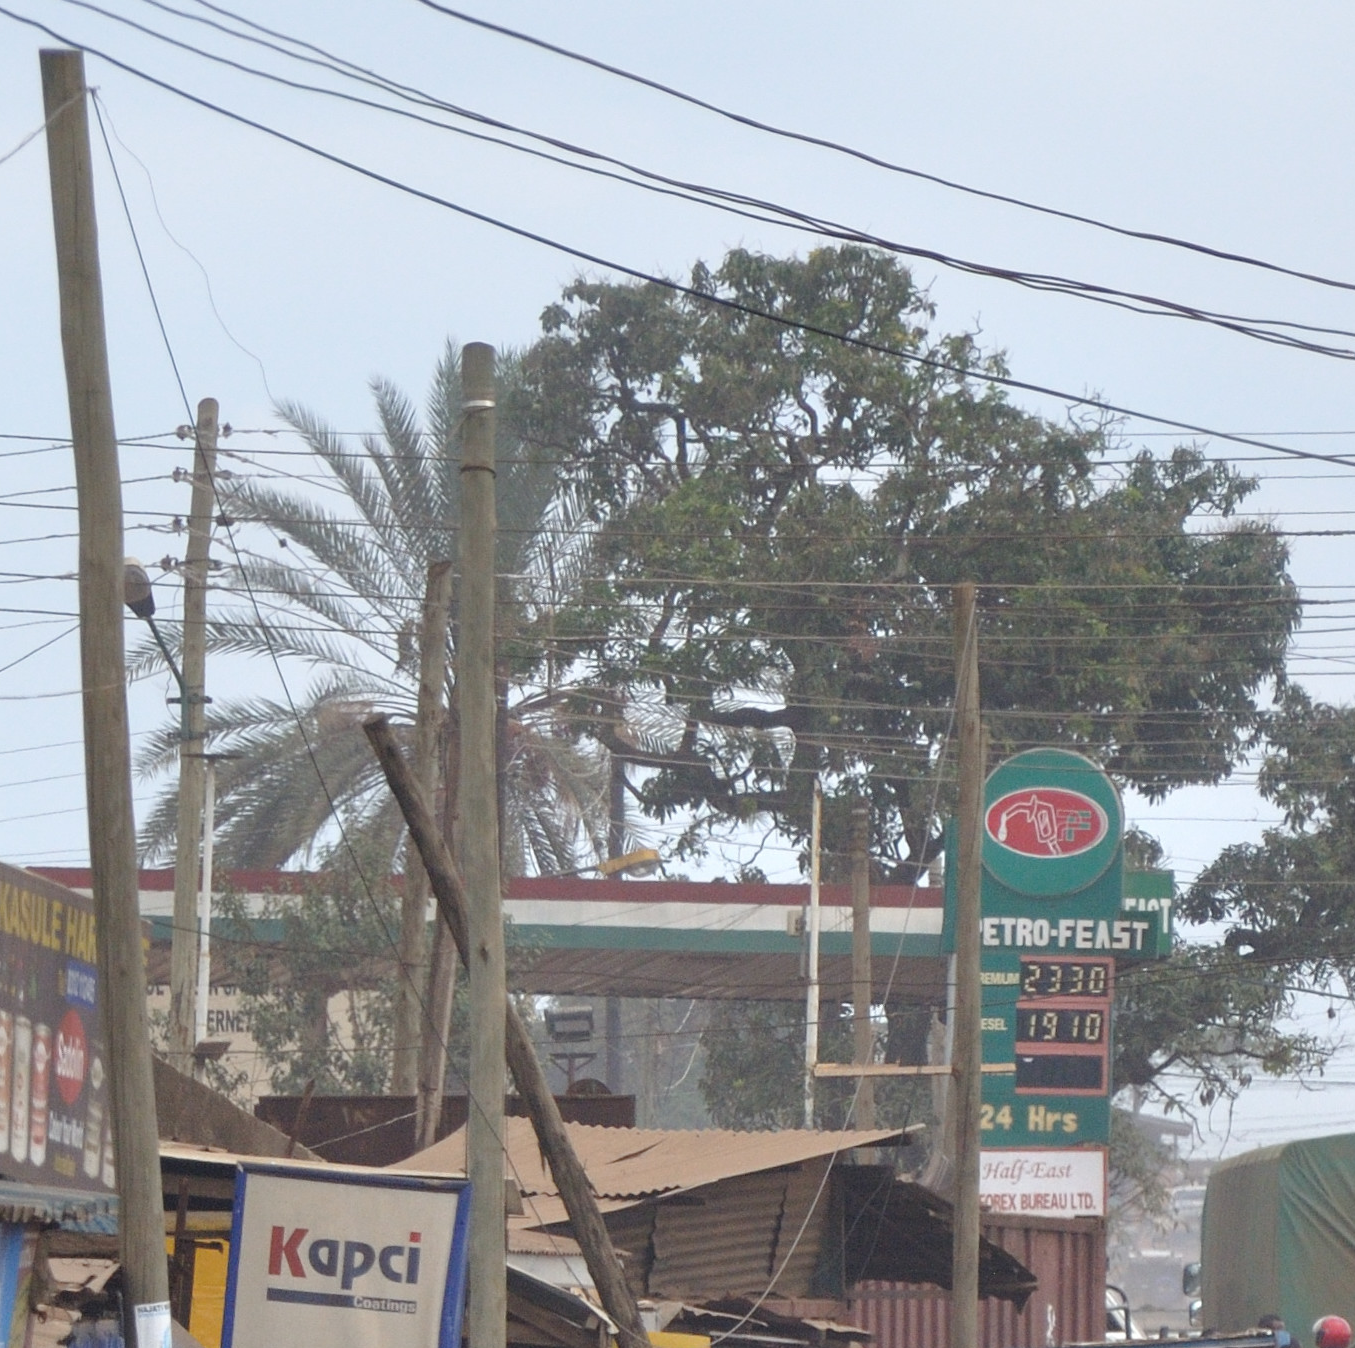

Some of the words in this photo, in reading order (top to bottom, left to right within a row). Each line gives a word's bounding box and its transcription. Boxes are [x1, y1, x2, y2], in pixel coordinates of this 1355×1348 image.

[980, 917, 1149, 950] ETRO-FEAST
[980, 972, 1020, 986] REMIUM
[1023, 964, 1106, 994] 2330
[980, 1017, 1008, 1031] ESEL
[1029, 1011, 1102, 1041] 1910
[980, 1103, 1013, 1130] 24
[1028, 1104, 1079, 1133] Hrs
[982, 1158, 1073, 1185] Half-East
[1021, 1192, 1068, 1210] BUREAU
[268, 1225, 422, 1290] Kapci
[353, 1296, 417, 1314] Coatings
